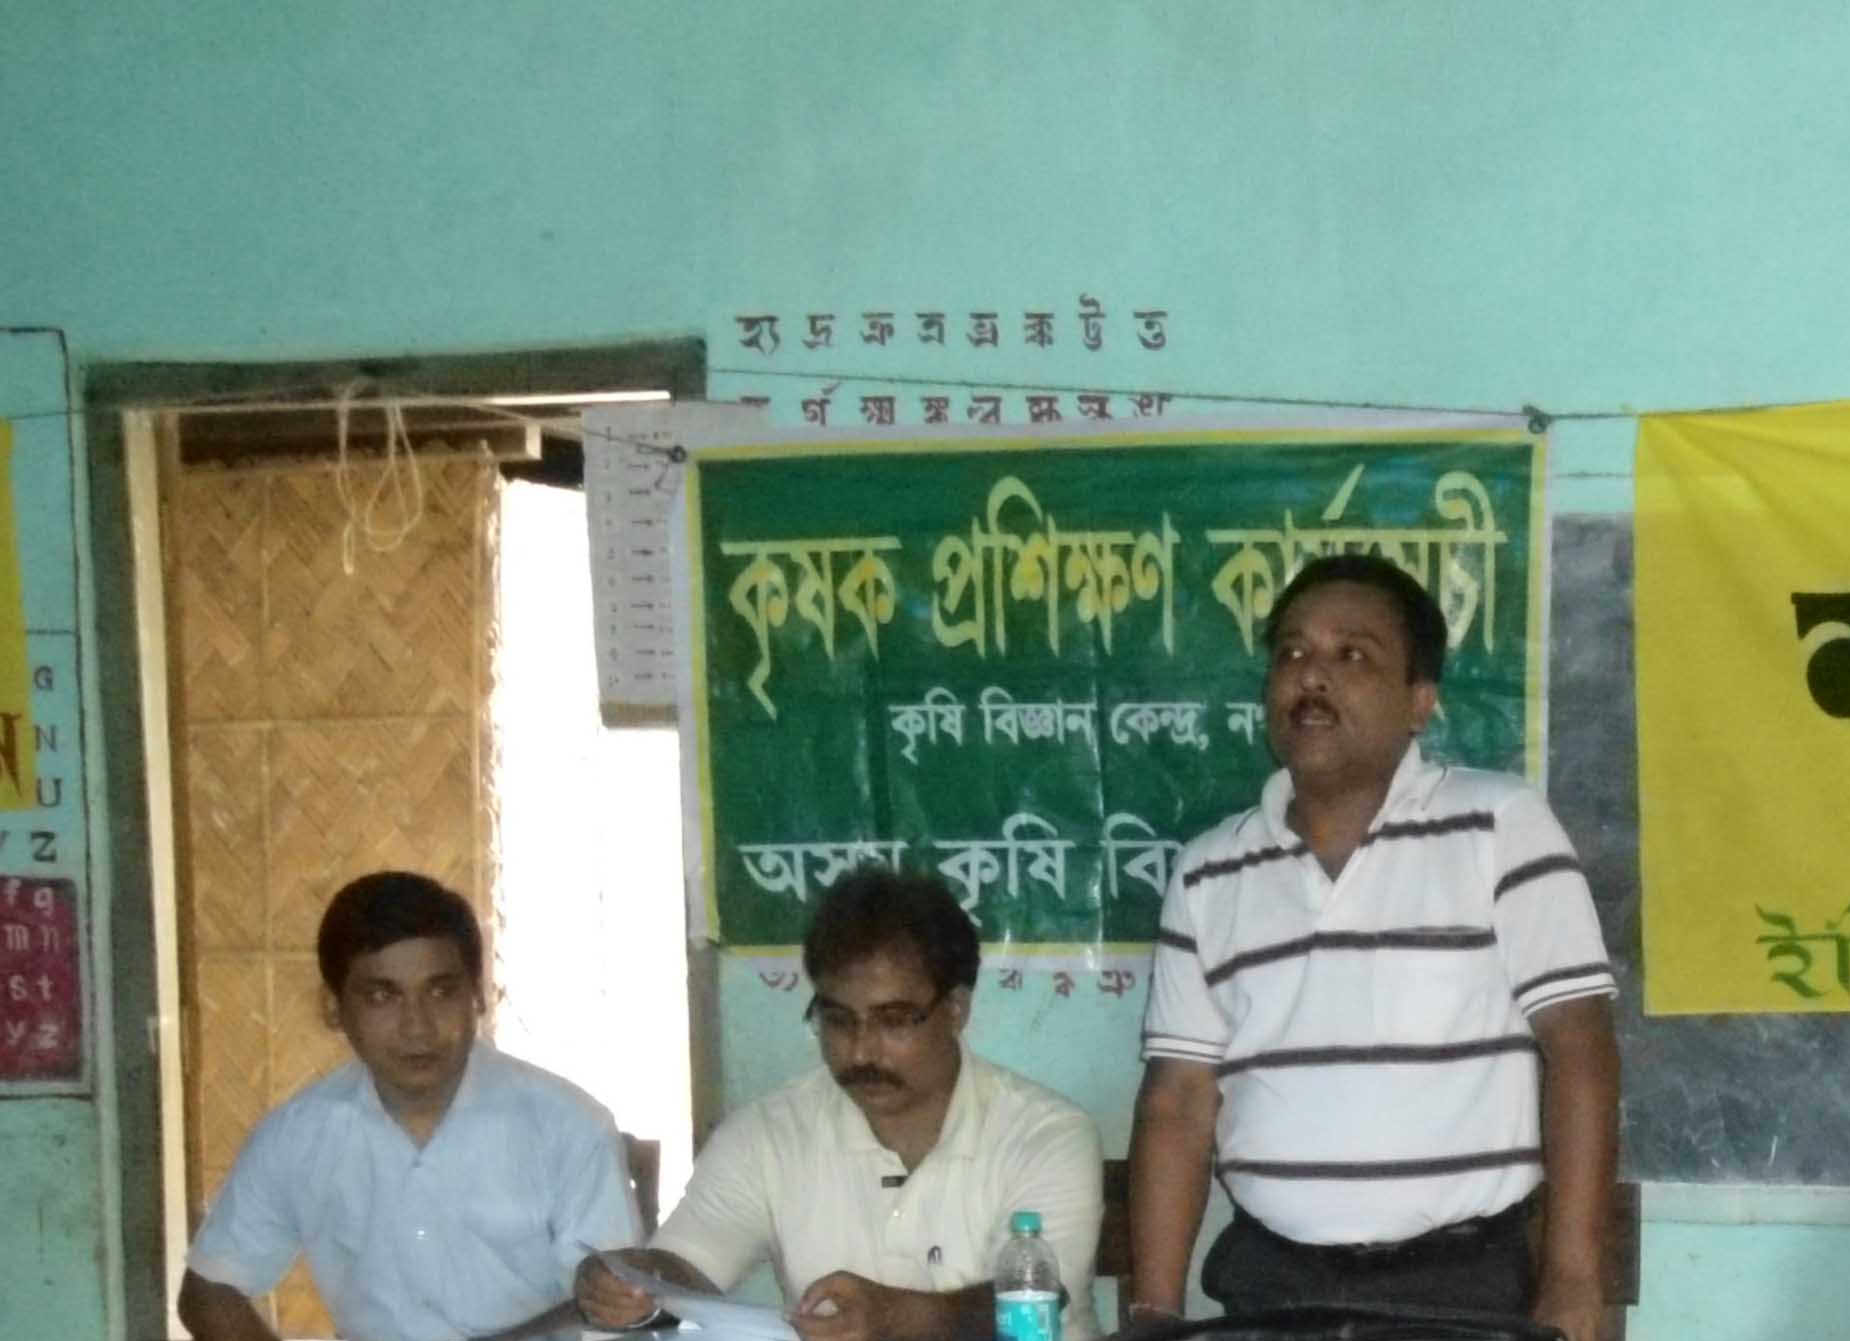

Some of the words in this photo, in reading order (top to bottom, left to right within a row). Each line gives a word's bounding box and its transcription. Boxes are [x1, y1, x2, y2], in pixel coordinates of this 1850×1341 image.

[720, 535, 902, 721] কৃষক
[888, 685, 967, 766] কৃষি
[979, 685, 1098, 746] বিজ্ঞান
[932, 811, 1076, 928] কৃষি
